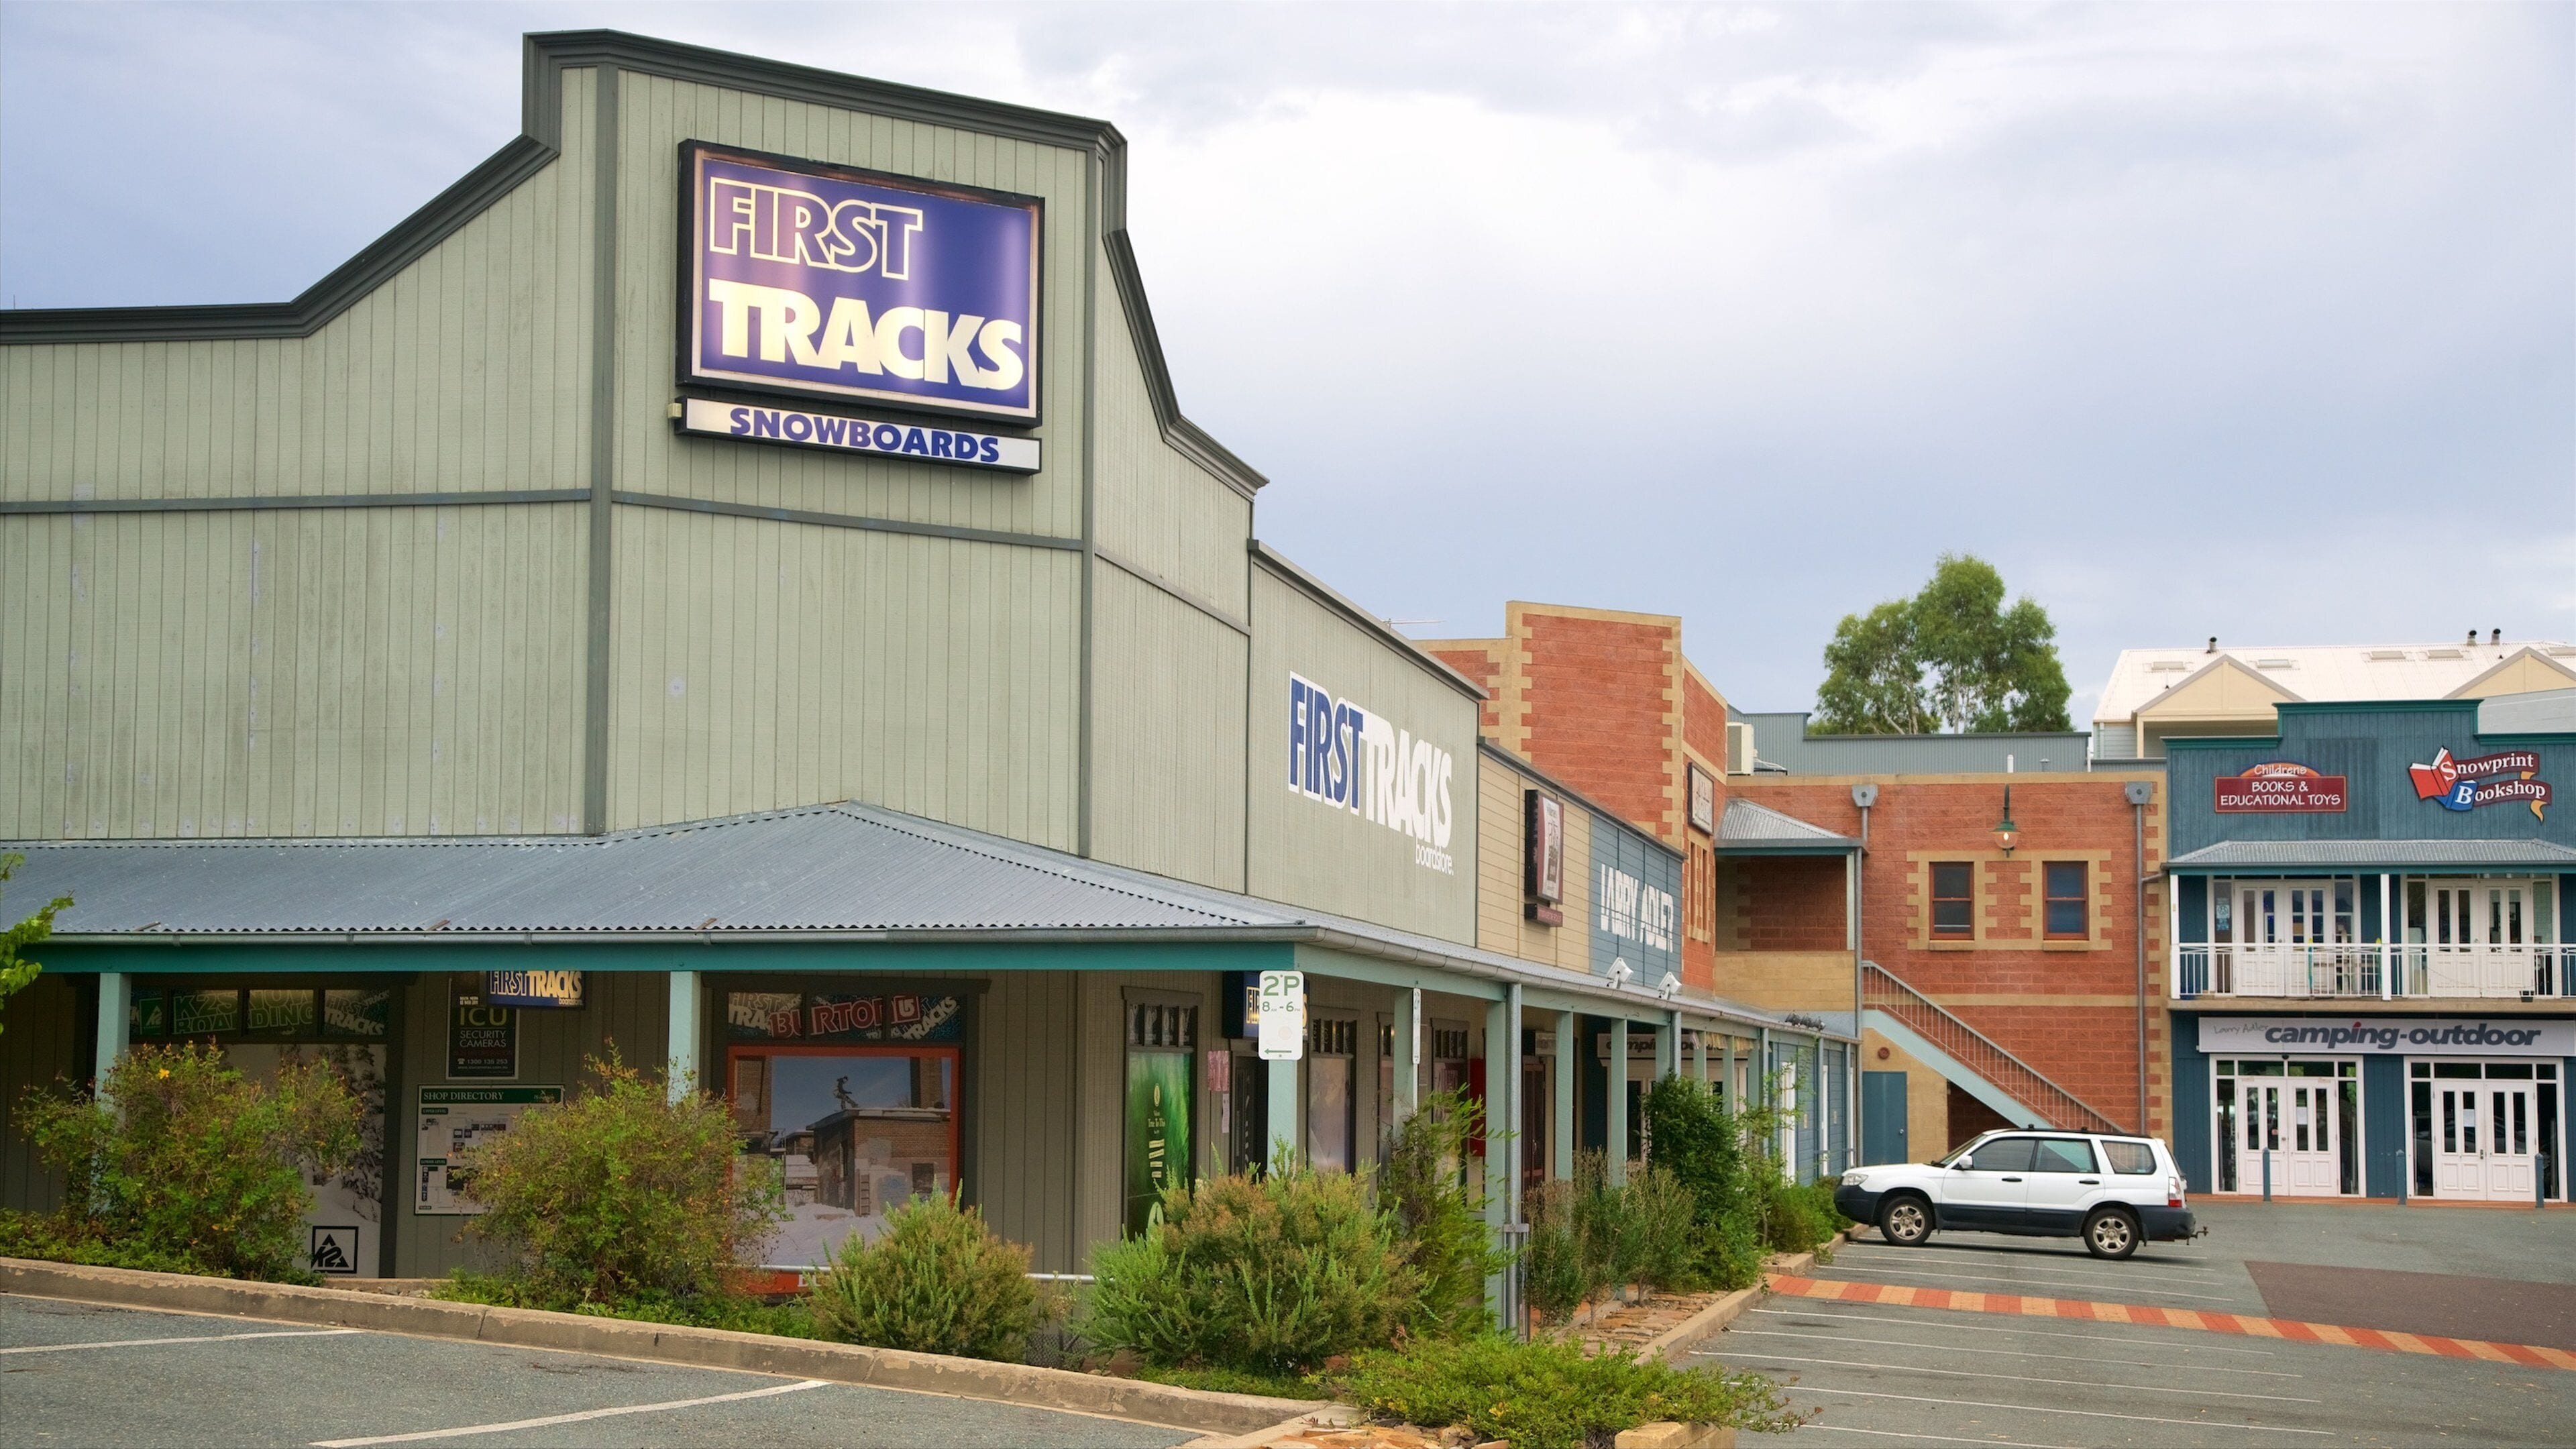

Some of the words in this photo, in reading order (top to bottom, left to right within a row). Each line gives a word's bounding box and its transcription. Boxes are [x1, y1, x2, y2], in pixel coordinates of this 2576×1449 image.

[709, 176, 923, 280] FIRST
[708, 278, 1024, 391] TRACKS
[730, 407, 1000, 463] SNOWBOARDS
[1289, 670, 1366, 816] FIRST
[1362, 712, 1452, 849] TRACKS
[2254, 763, 2308, 776] Childrens
[2440, 753, 2534, 782] Snowprint
[2251, 781, 2294, 792] BOOKS
[2299, 781, 2309, 792] &
[2455, 780, 2546, 804] Bookshop
[2220, 794, 2305, 806] EDUCATIONAL
[2308, 794, 2341, 806] TOYS
[1600, 863, 1639, 941] LARRY
[1639, 879, 1674, 953] ADLER
[1263, 975, 1300, 996] 2P
[460, 1006, 508, 1026] ICU
[460, 1030, 506, 1039] SECURITY
[460, 1039, 507, 1048] CAMERAS
[423, 1091, 447, 1100] SHOP
[450, 1091, 504, 1100] DIRECTORY
